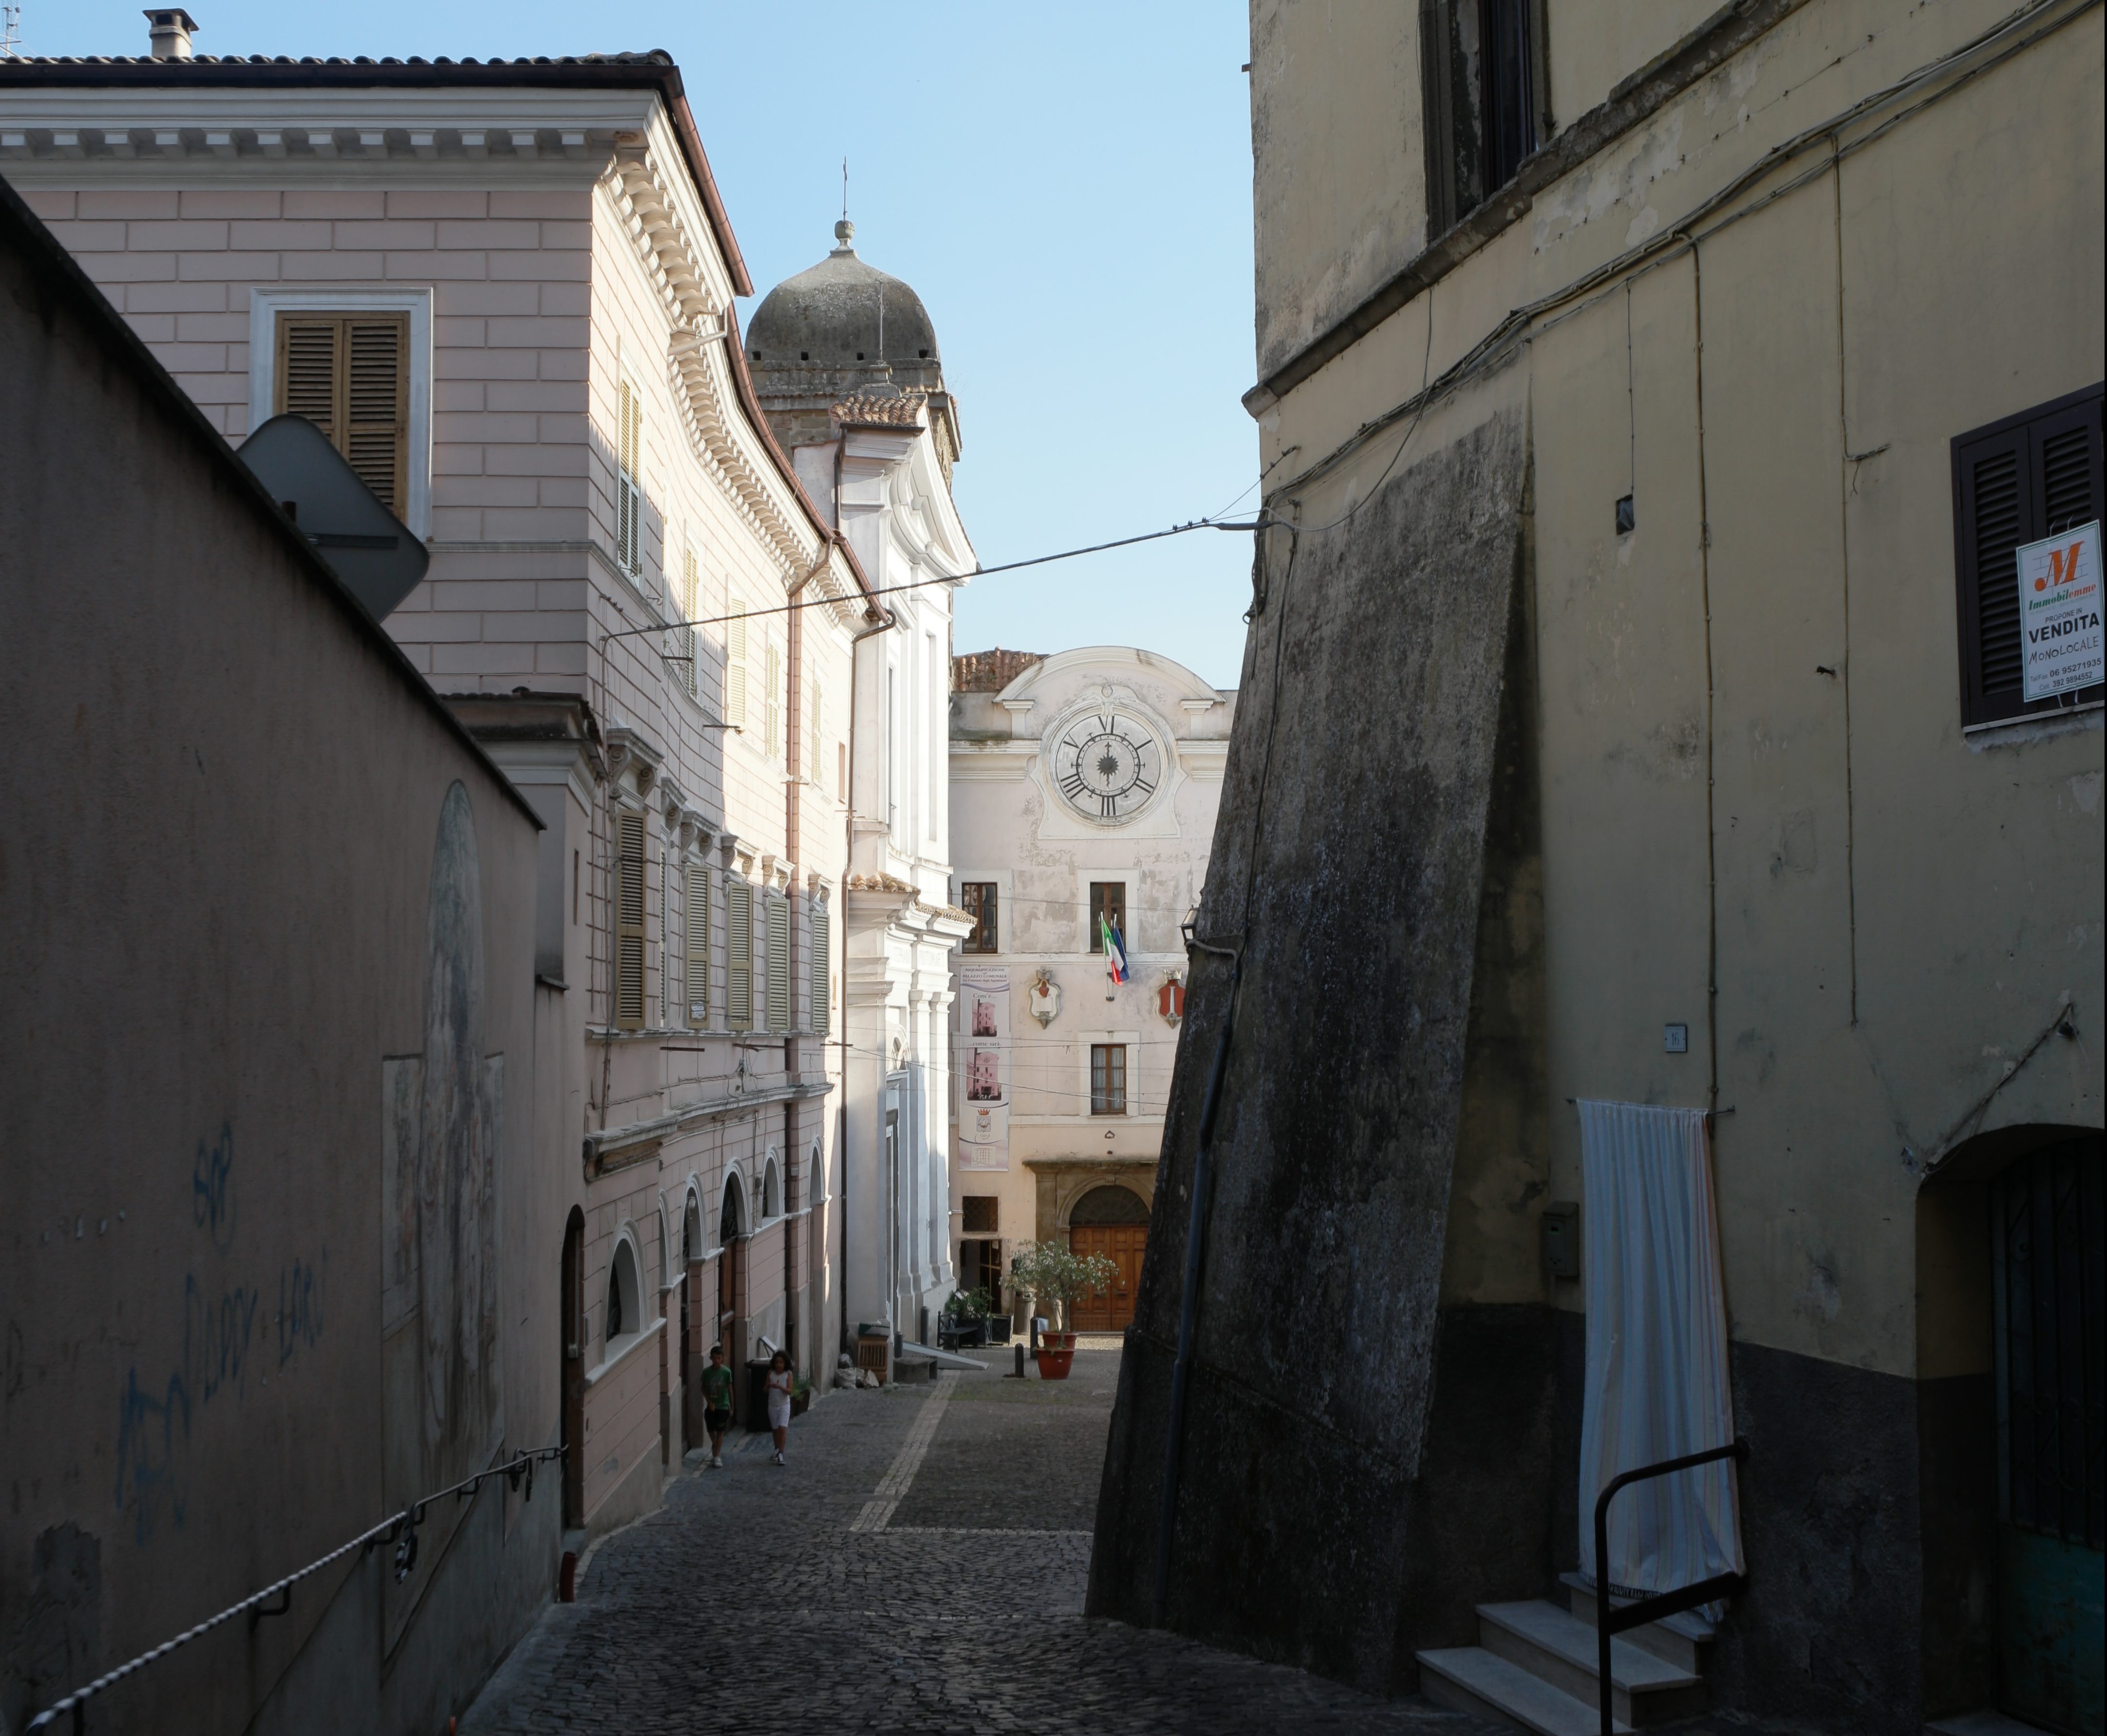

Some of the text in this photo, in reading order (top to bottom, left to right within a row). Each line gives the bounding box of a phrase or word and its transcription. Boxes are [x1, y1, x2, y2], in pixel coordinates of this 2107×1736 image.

[2029, 584, 2096, 611] Immobilemme
[2045, 609, 2075, 623] PROPONE
[2029, 612, 2100, 643] VENDITA
[2029, 635, 2099, 665] MONOLOCALE
[2050, 669, 2060, 678] 06
[2062, 658, 2102, 675] 95271935
[2052, 679, 2065, 688] 392
[2066, 671, 2093, 684] 9894552
[1671, 1032, 1680, 1046] 16
